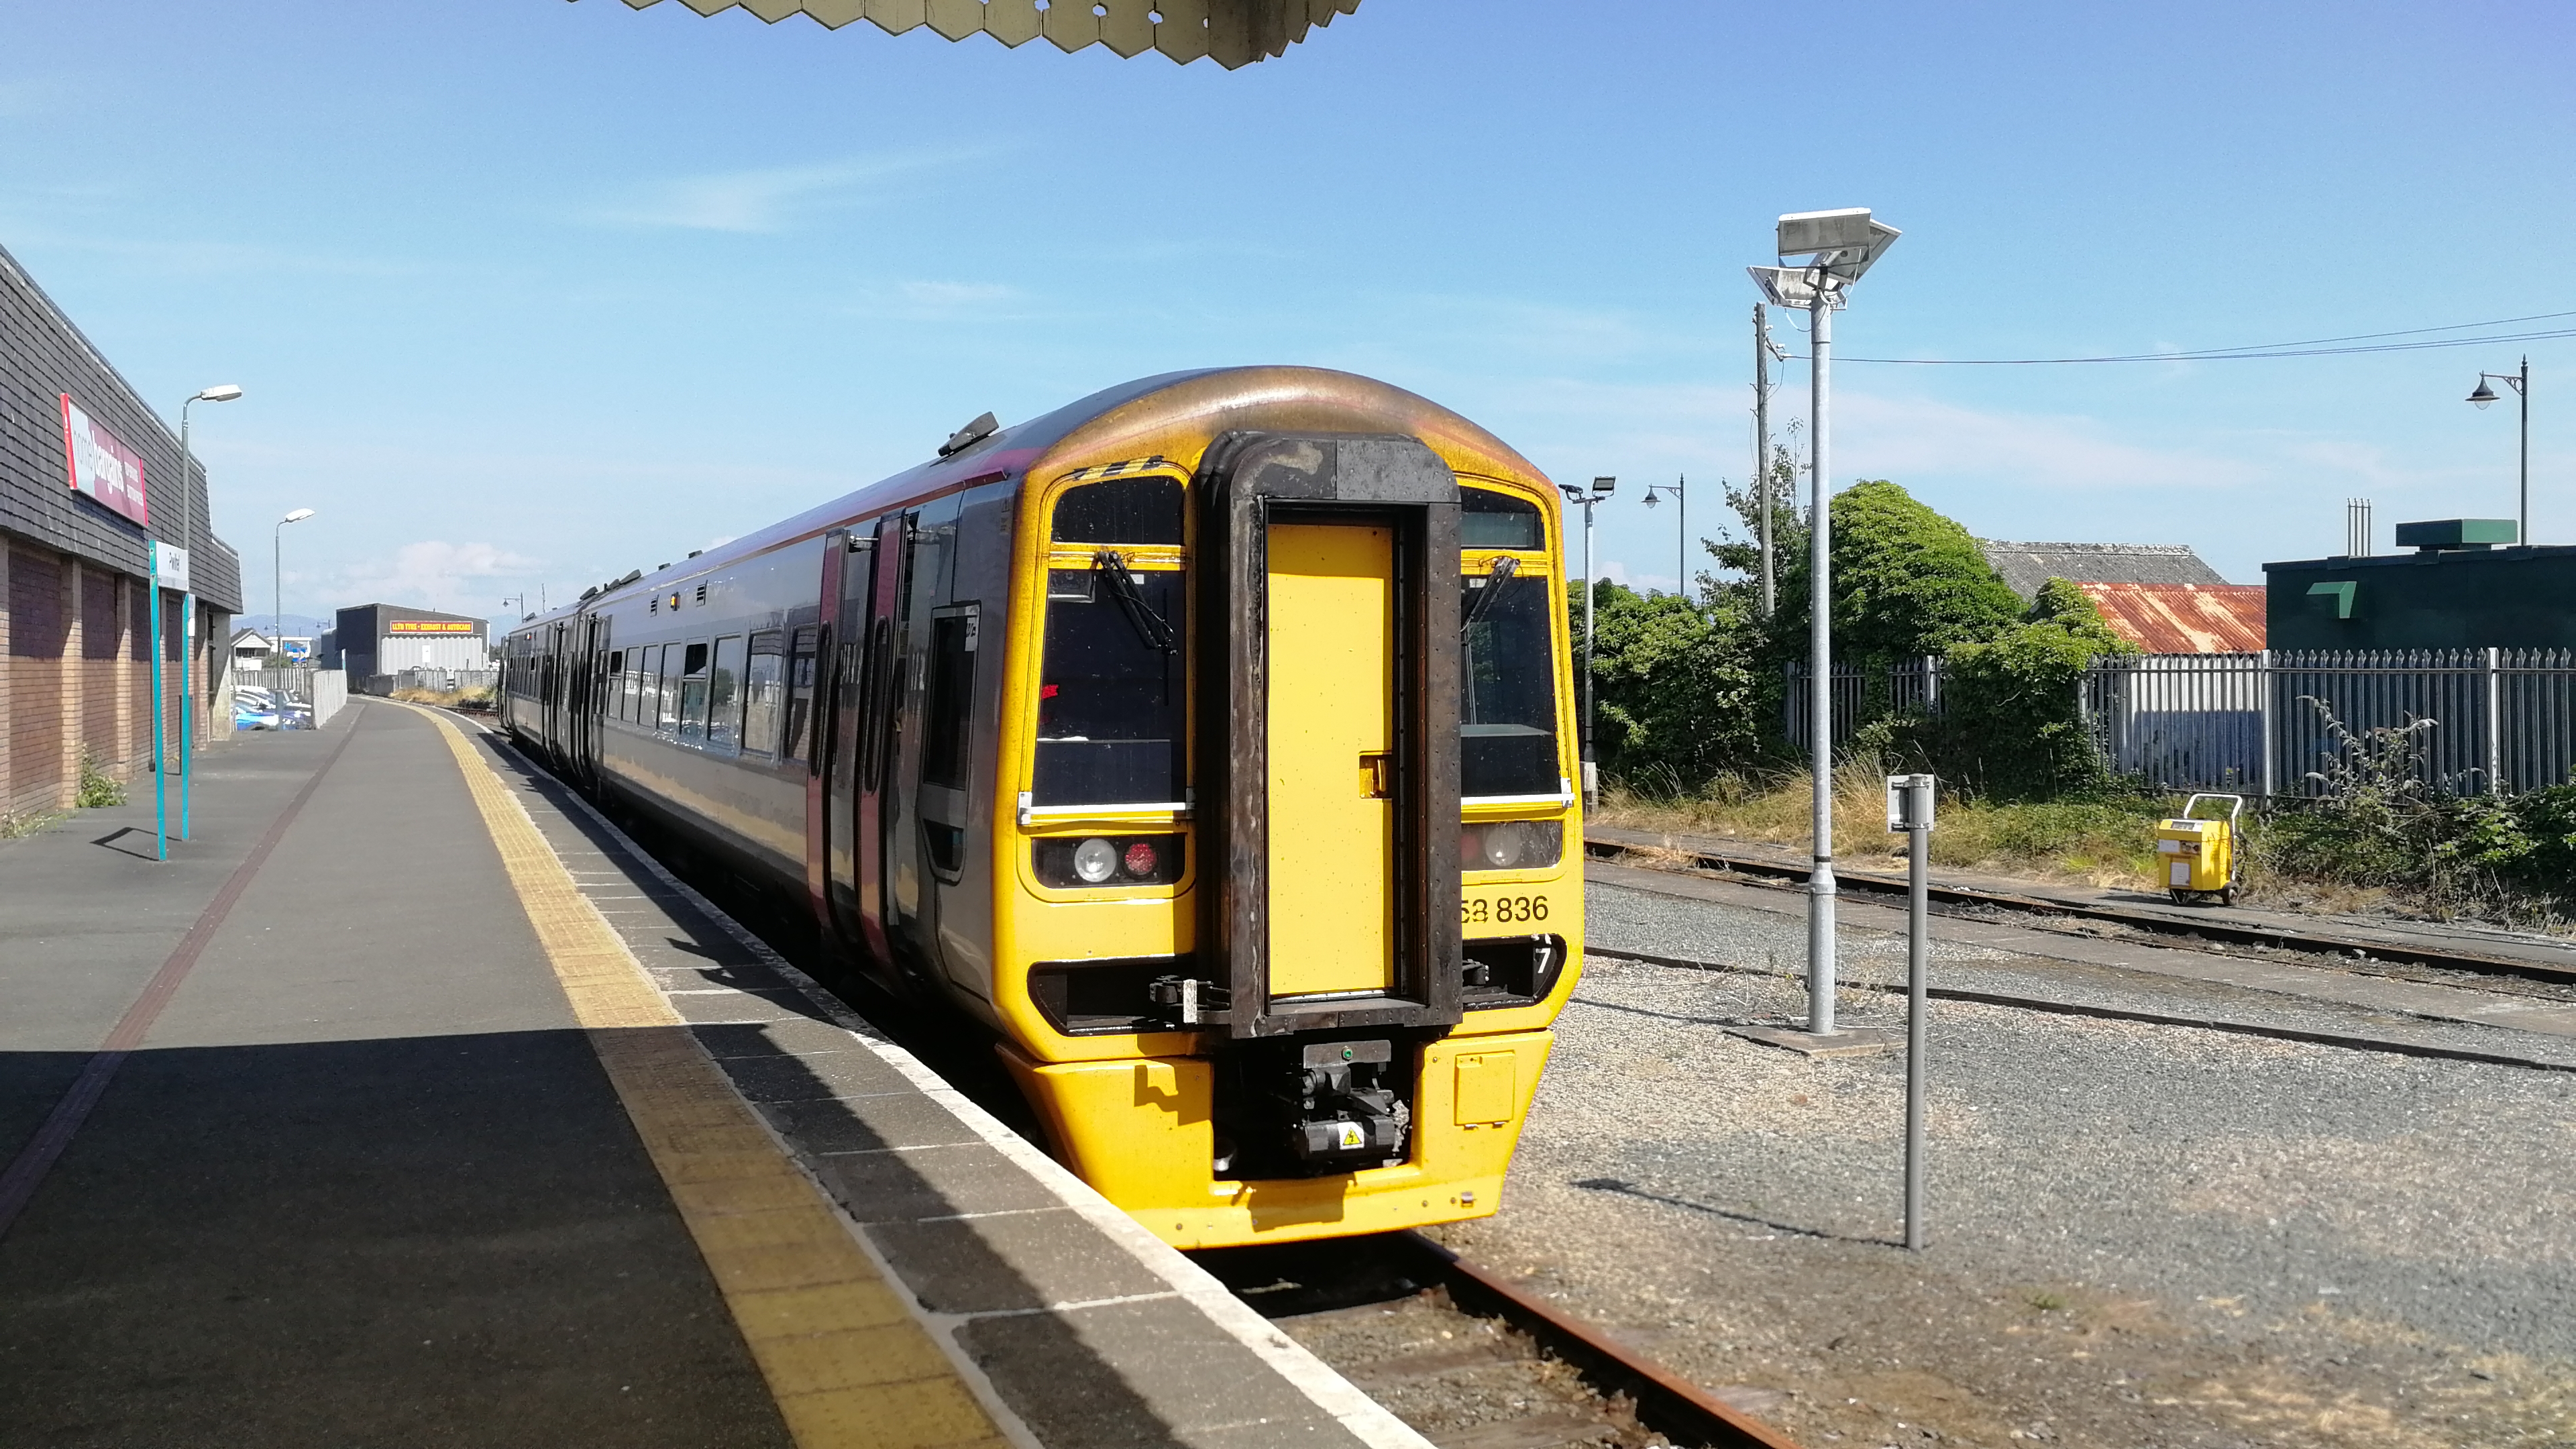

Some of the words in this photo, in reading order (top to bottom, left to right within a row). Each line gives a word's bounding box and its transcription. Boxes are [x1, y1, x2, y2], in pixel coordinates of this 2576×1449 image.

[91, 430, 124, 494] bargains
[1496, 895, 1549, 923] 836
[1536, 947, 1551, 973] 7
